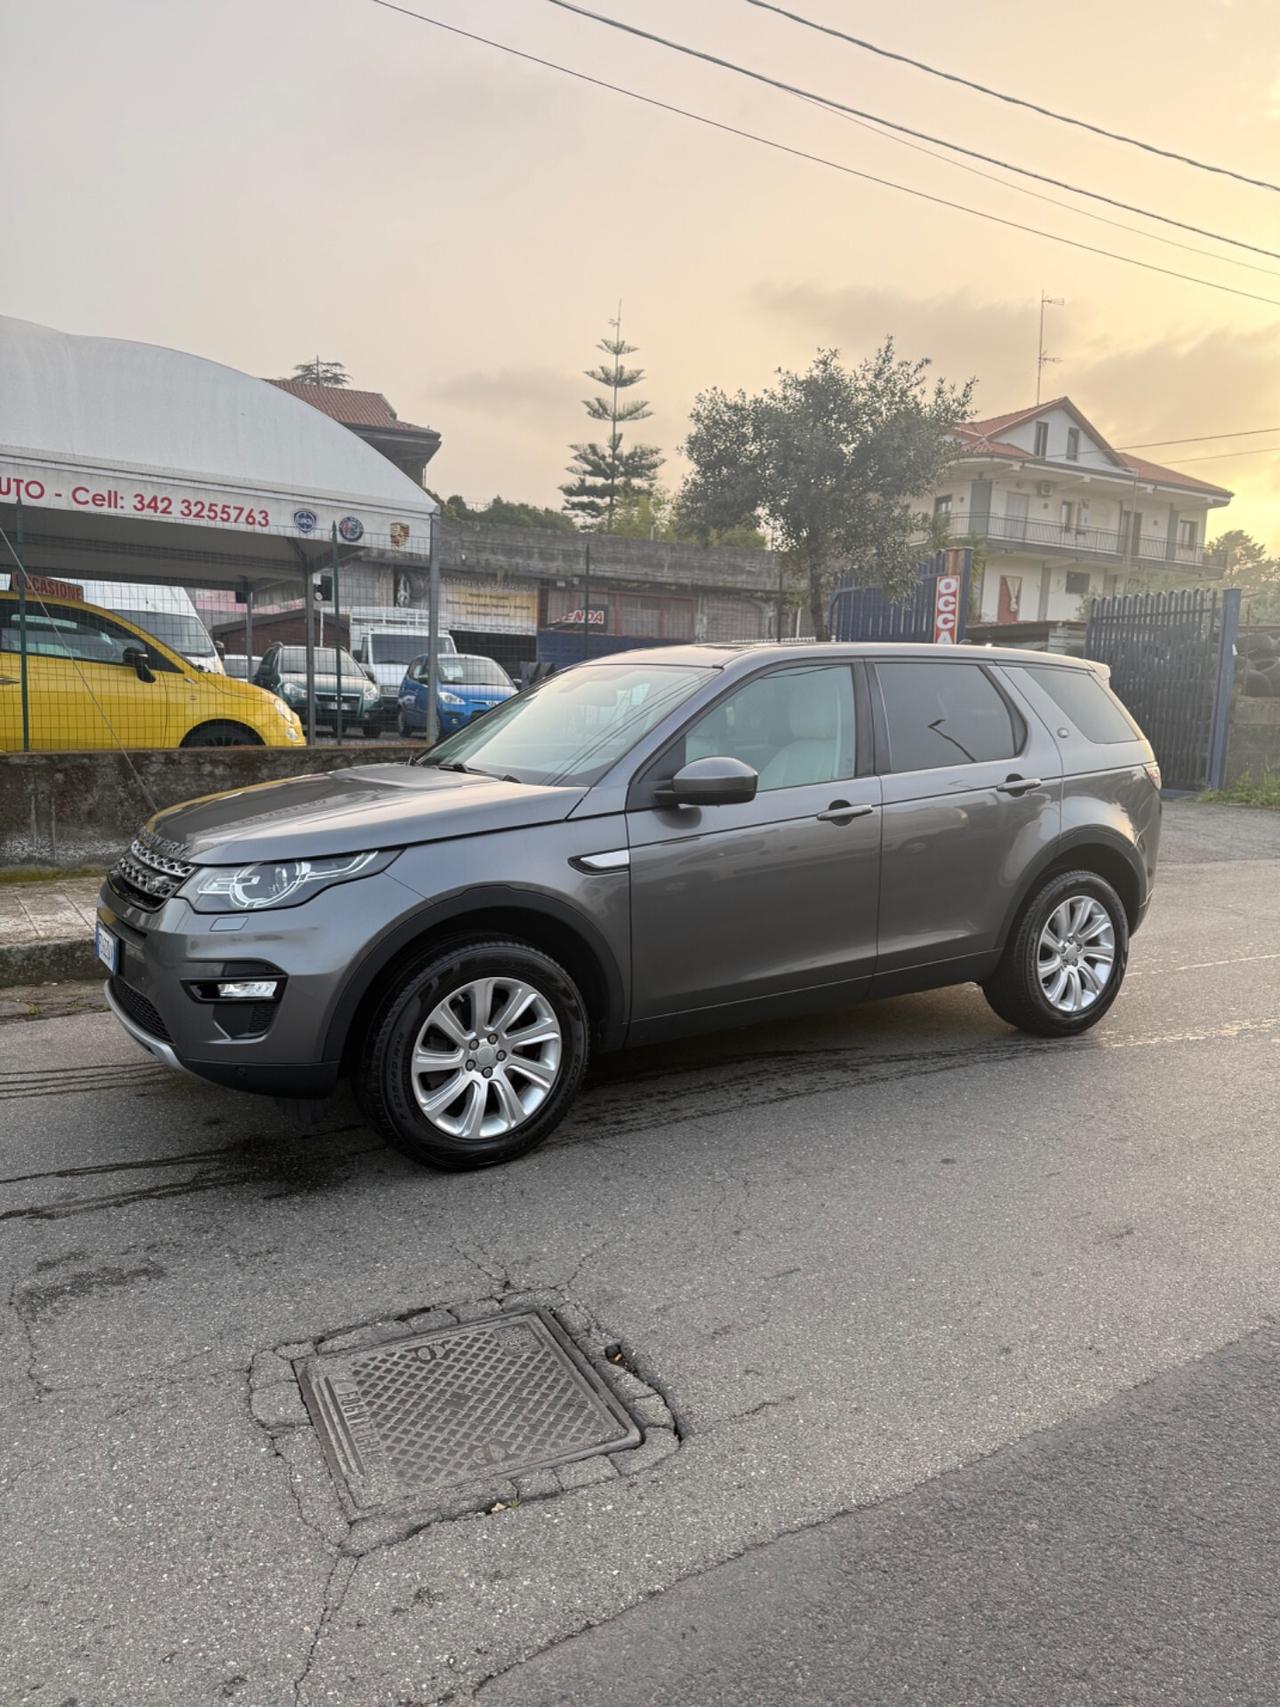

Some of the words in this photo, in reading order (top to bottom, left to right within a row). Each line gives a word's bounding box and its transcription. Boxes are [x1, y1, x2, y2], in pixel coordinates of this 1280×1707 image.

[71, 486, 125, 510] Cell:
[132, 493, 173, 515] 342
[180, 499, 270, 527] 3255763
[551, 609, 605, 625] ENDA
